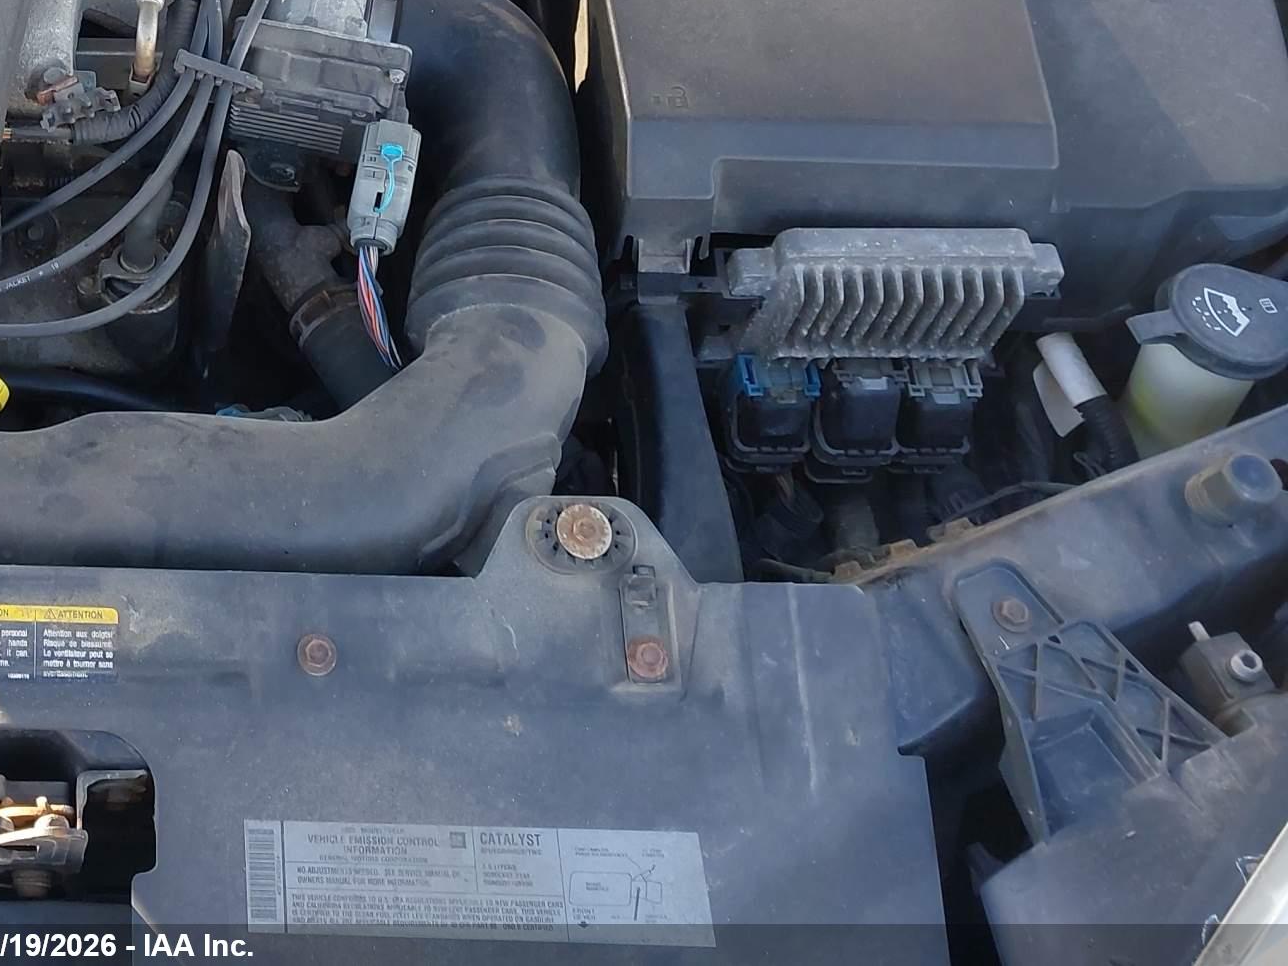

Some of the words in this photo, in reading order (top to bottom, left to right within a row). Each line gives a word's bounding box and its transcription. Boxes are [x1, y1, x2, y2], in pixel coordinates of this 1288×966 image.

[5, 275, 32, 290] JACKET
[58, 609, 103, 619] ATTENTION
[43, 628, 72, 638] Attention
[307, 833, 345, 844] VEHICLE
[348, 834, 394, 846] EMISSION
[396, 835, 439, 847] CONTROL
[480, 832, 541, 847] CATALYST
[343, 845, 408, 855] INFORMATION
